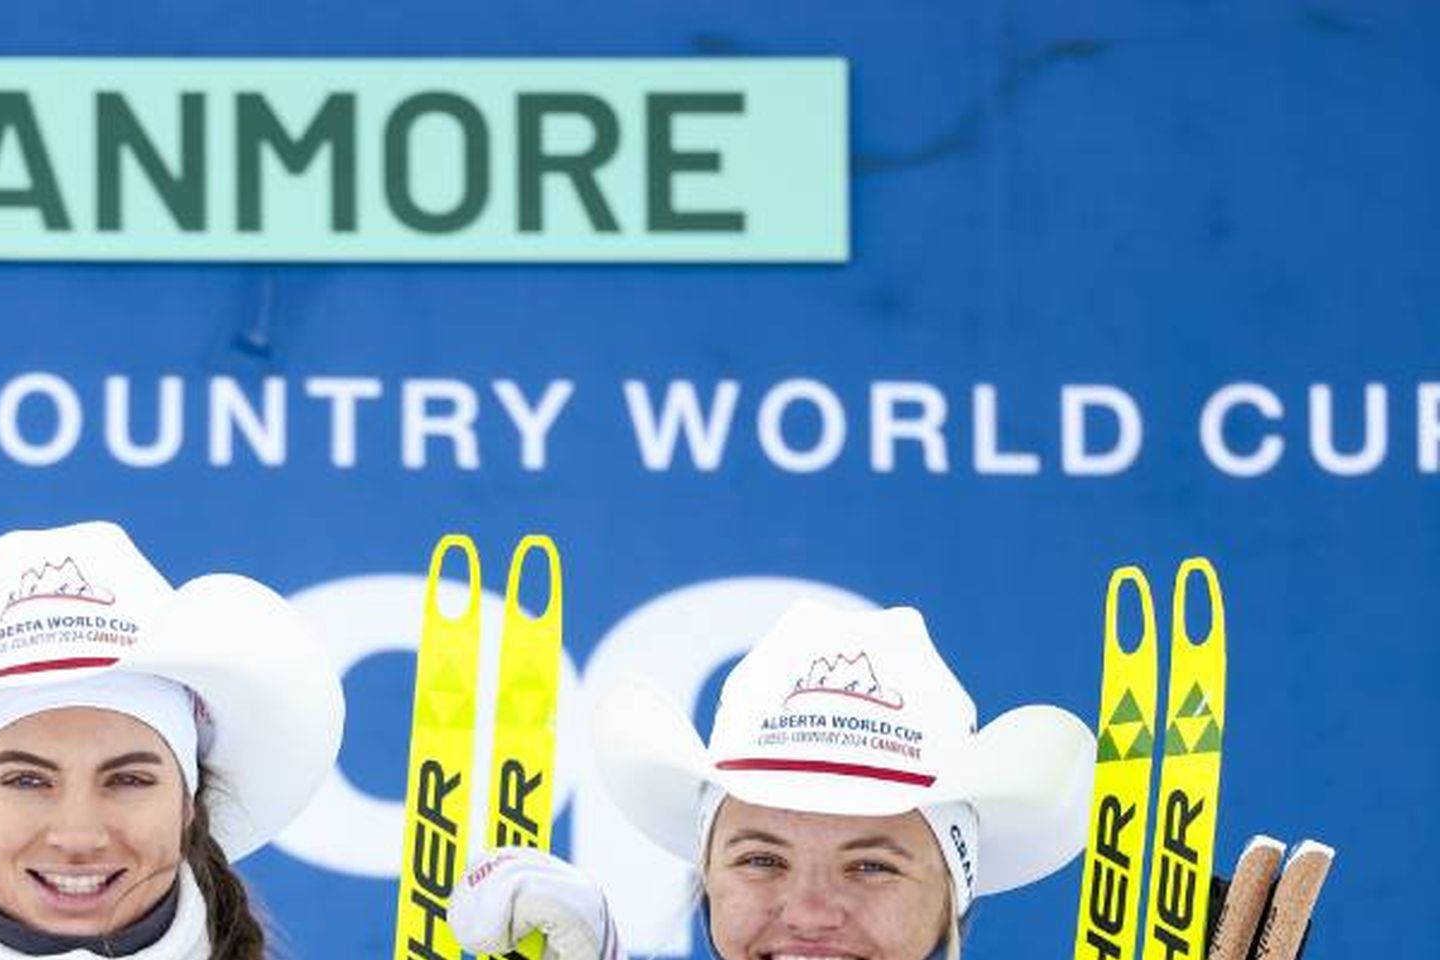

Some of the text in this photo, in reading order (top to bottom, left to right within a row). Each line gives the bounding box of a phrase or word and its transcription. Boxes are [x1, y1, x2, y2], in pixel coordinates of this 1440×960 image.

[622, 378, 1143, 477] WORLD
[46, 614, 107, 631] WORLD
[109, 617, 140, 635] CUP
[760, 714, 923, 743] ALBERTA WORLD CUP
